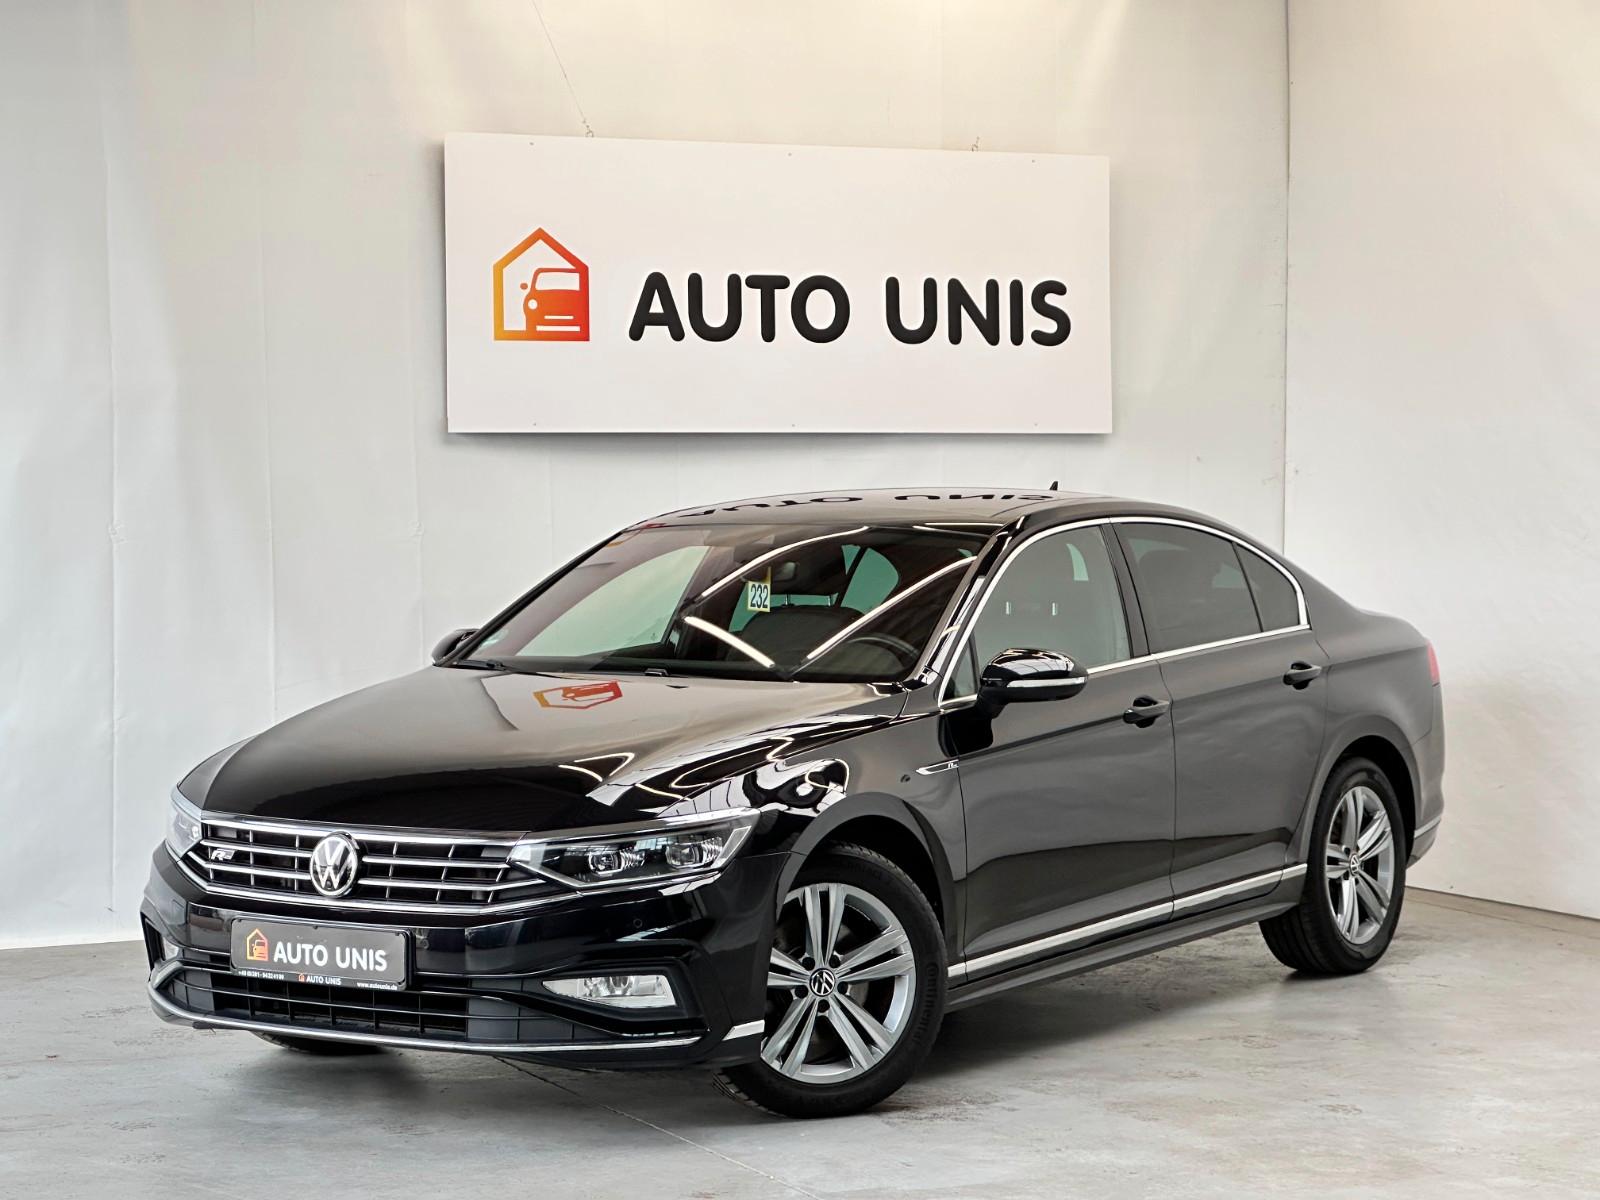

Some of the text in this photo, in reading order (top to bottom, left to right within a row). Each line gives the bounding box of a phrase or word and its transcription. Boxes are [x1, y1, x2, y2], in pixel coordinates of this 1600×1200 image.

[628, 271, 1072, 347] AUTO UNIS
[750, 583, 769, 609] 232
[312, 835, 357, 896] VW
[273, 941, 388, 972] AUTO UNIS
[306, 975, 341, 985] AUTO UNIS
